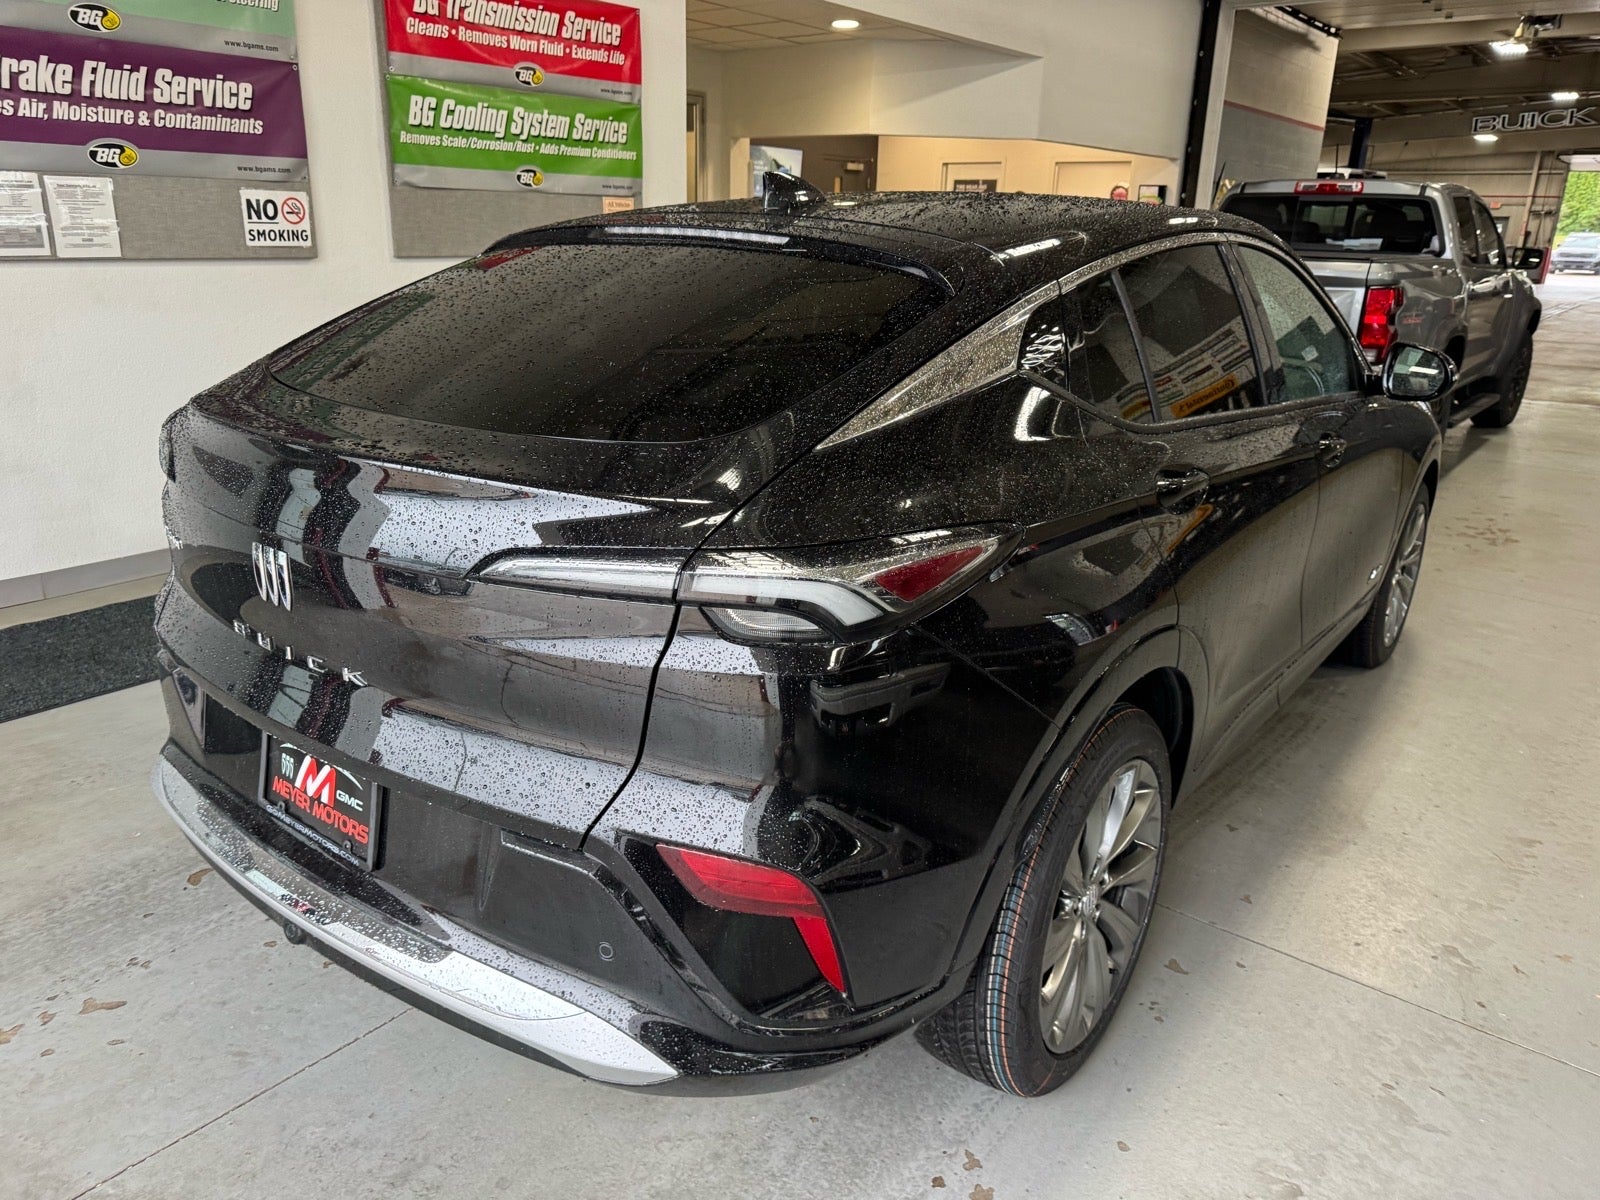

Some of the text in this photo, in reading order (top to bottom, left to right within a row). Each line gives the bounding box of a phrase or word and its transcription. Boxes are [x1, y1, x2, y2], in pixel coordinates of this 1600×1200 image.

[406, 17, 625, 65] Cleans Removes Worn Fluid Extends Life
[561, 10, 621, 46] Service
[224, 40, 279, 52] www.bgams.com
[81, 60, 148, 102] Fluid
[153, 68, 253, 111] Service
[17, 97, 49, 121] Air,
[52, 100, 135, 125] Moisture
[138, 111, 151, 126] &
[154, 109, 264, 135] Contaminants
[408, 95, 628, 144] BG Cooling System Service
[1471, 106, 1599, 134] BUICK
[400, 131, 637, 160] Removes Scale/Corrosion/Rust Adds Premium Conditioners
[246, 199, 279, 221] NO
[248, 229, 309, 242] SMOKING
[272, 775, 370, 844] MEYER MOTORS
[336, 789, 364, 812] GMC
